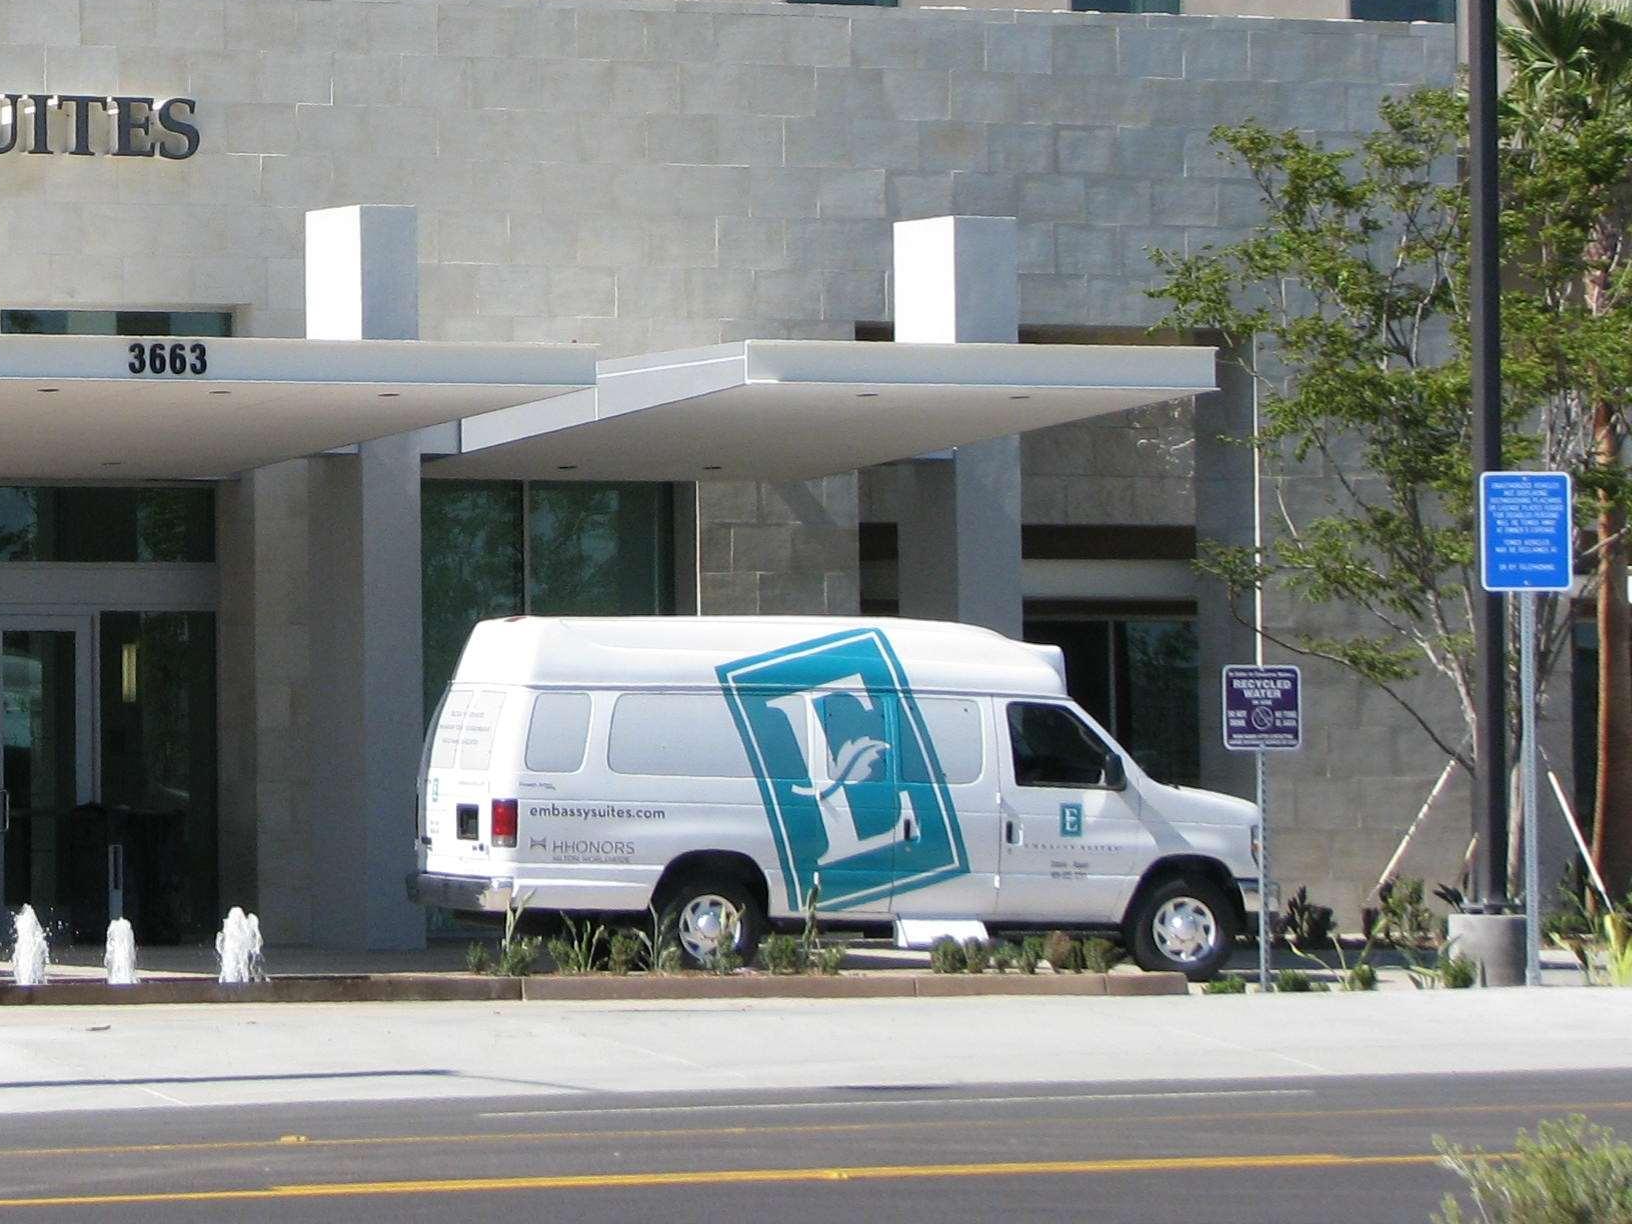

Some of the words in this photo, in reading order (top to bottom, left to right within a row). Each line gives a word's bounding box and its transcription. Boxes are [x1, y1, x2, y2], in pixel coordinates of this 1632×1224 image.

[128, 342, 208, 375] 3663
[1233, 679, 1292, 688] RECYCLED
[1243, 688, 1282, 698] WATER
[529, 803, 666, 821] embassysuites.com
[552, 840, 636, 855] HHONORS
